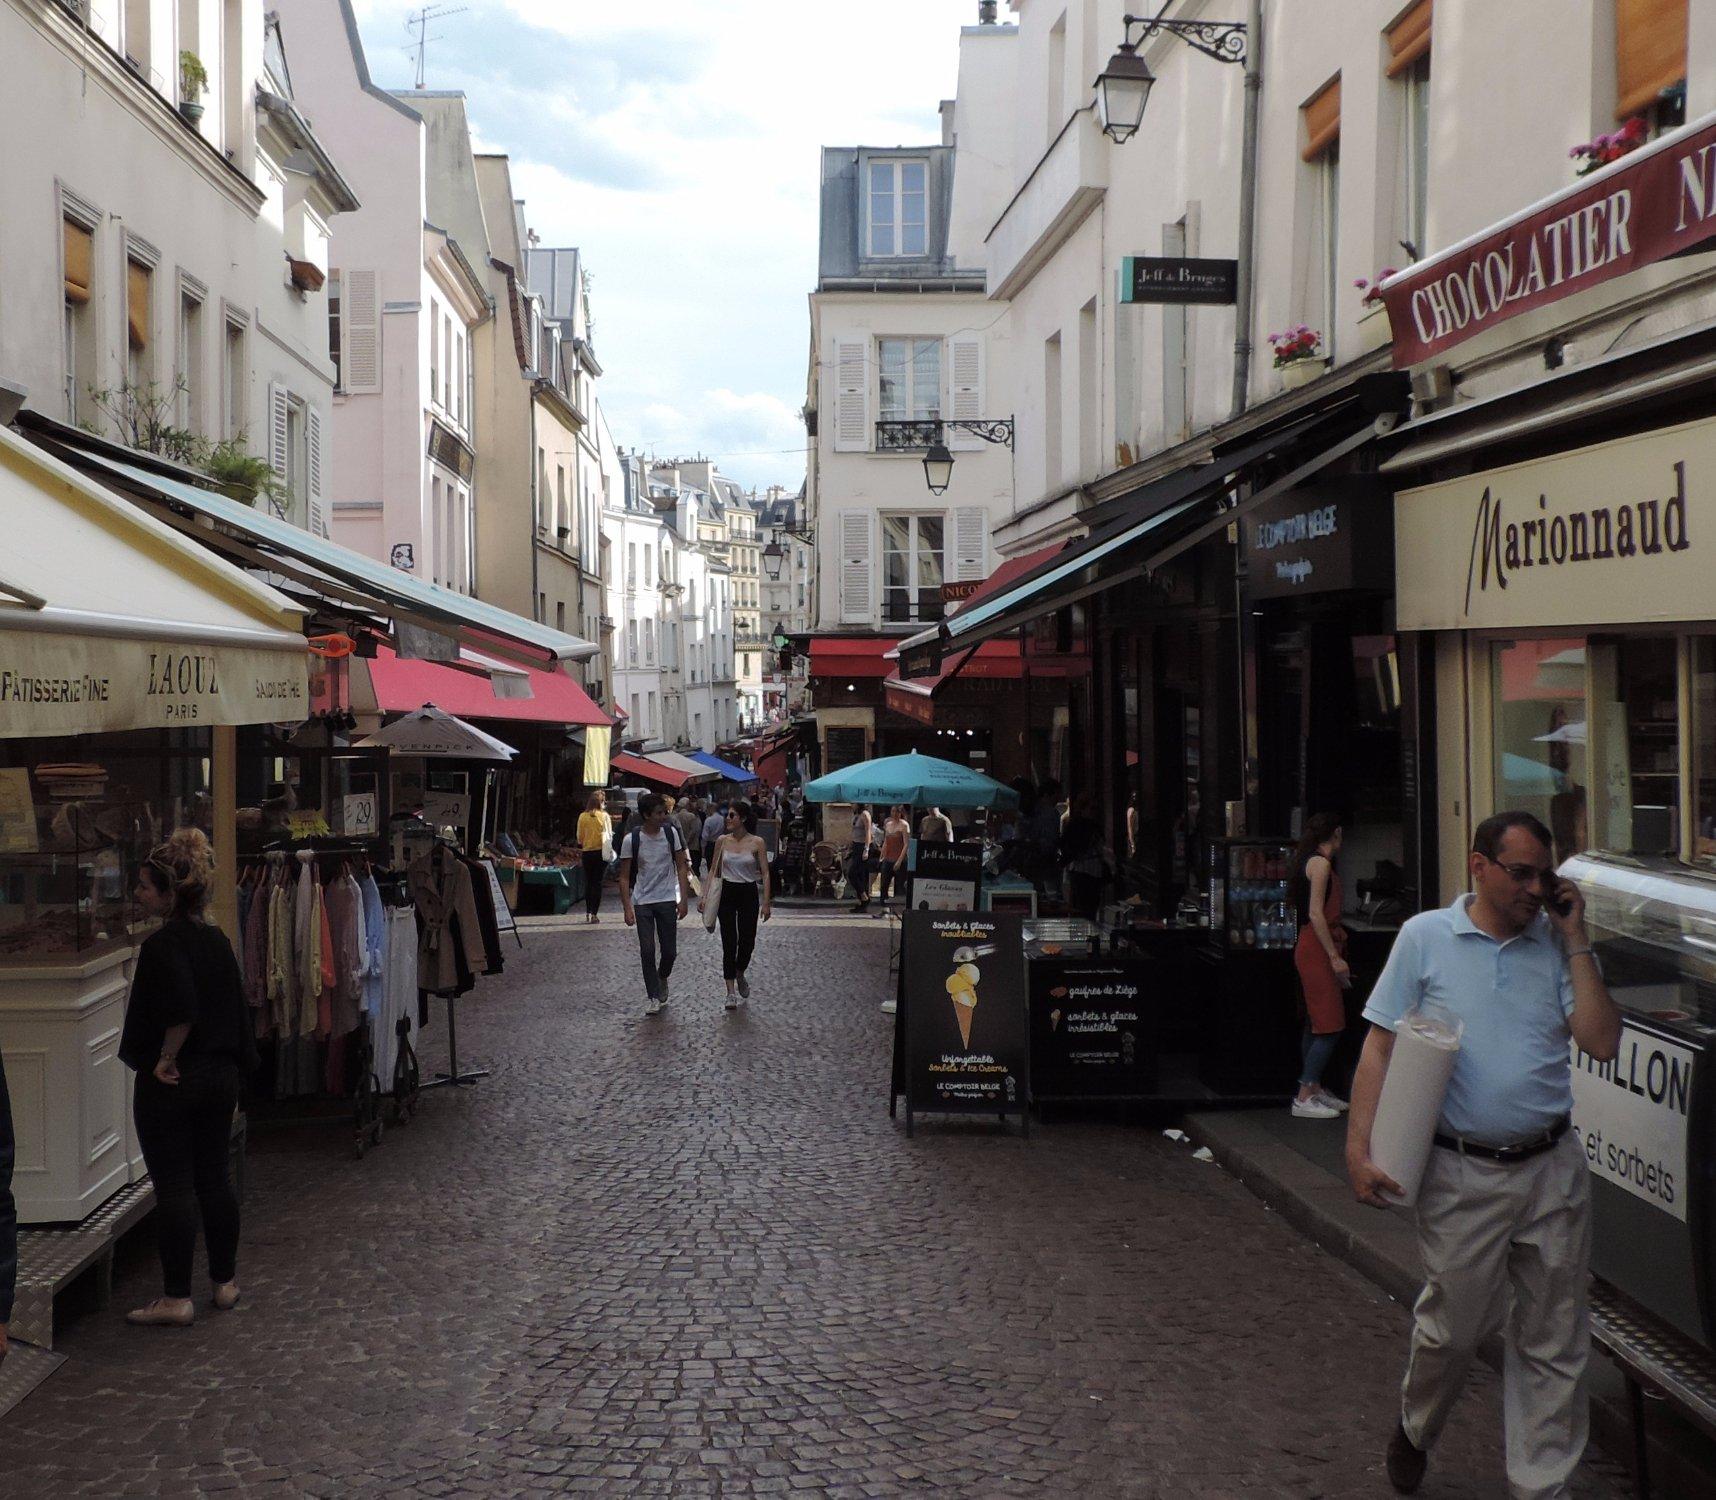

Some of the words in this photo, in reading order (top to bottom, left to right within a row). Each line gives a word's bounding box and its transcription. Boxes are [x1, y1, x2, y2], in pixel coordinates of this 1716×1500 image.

[1411, 189, 1632, 344] CHOCOLATIER
[1465, 460, 1691, 617] Marionnaud
[945, 585, 981, 599] NICO
[166, 703, 198, 719] PARIS
[1586, 1129, 1603, 1165] et
[1607, 1143, 1675, 1203] sorbets
